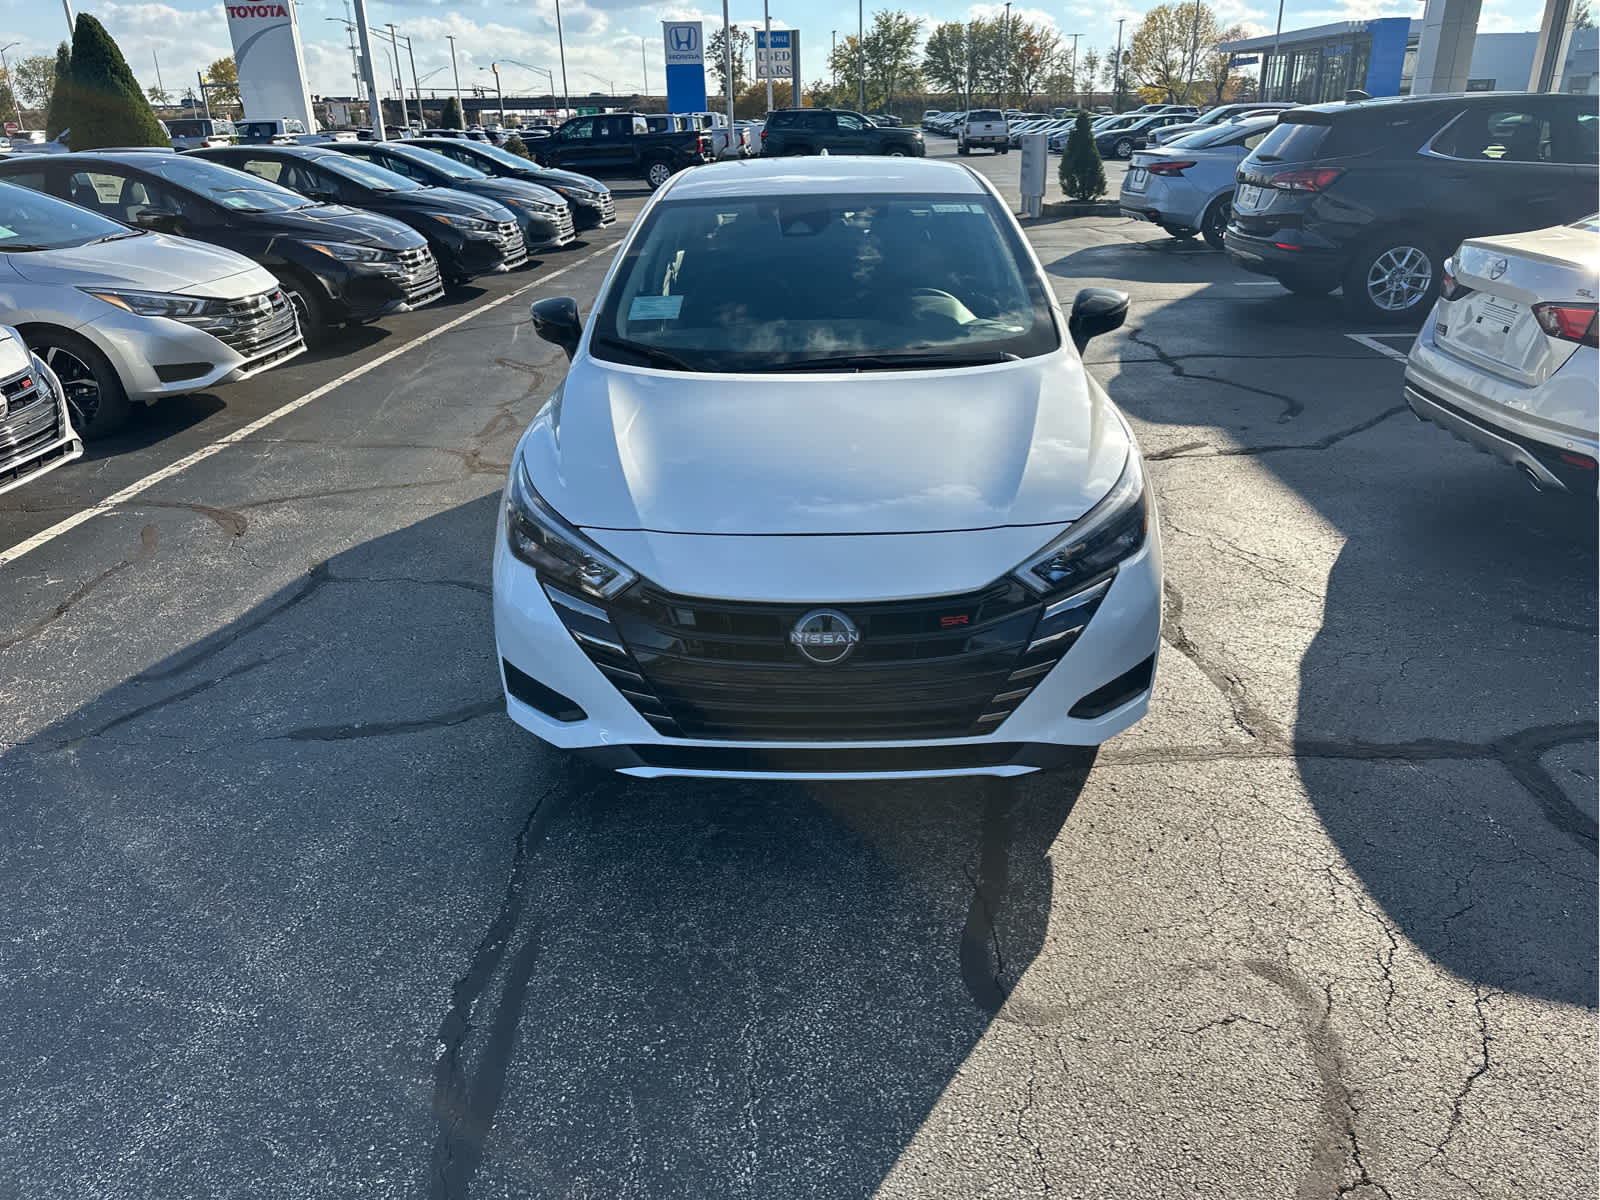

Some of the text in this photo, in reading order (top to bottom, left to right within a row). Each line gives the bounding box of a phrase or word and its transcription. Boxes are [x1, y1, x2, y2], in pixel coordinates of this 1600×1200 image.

[228, 5, 288, 19] TOYOTA
[760, 35, 787, 43] MORE
[1575, 288, 1595, 299] SL
[941, 614, 969, 627] SR
[790, 631, 859, 645] NISSAN
